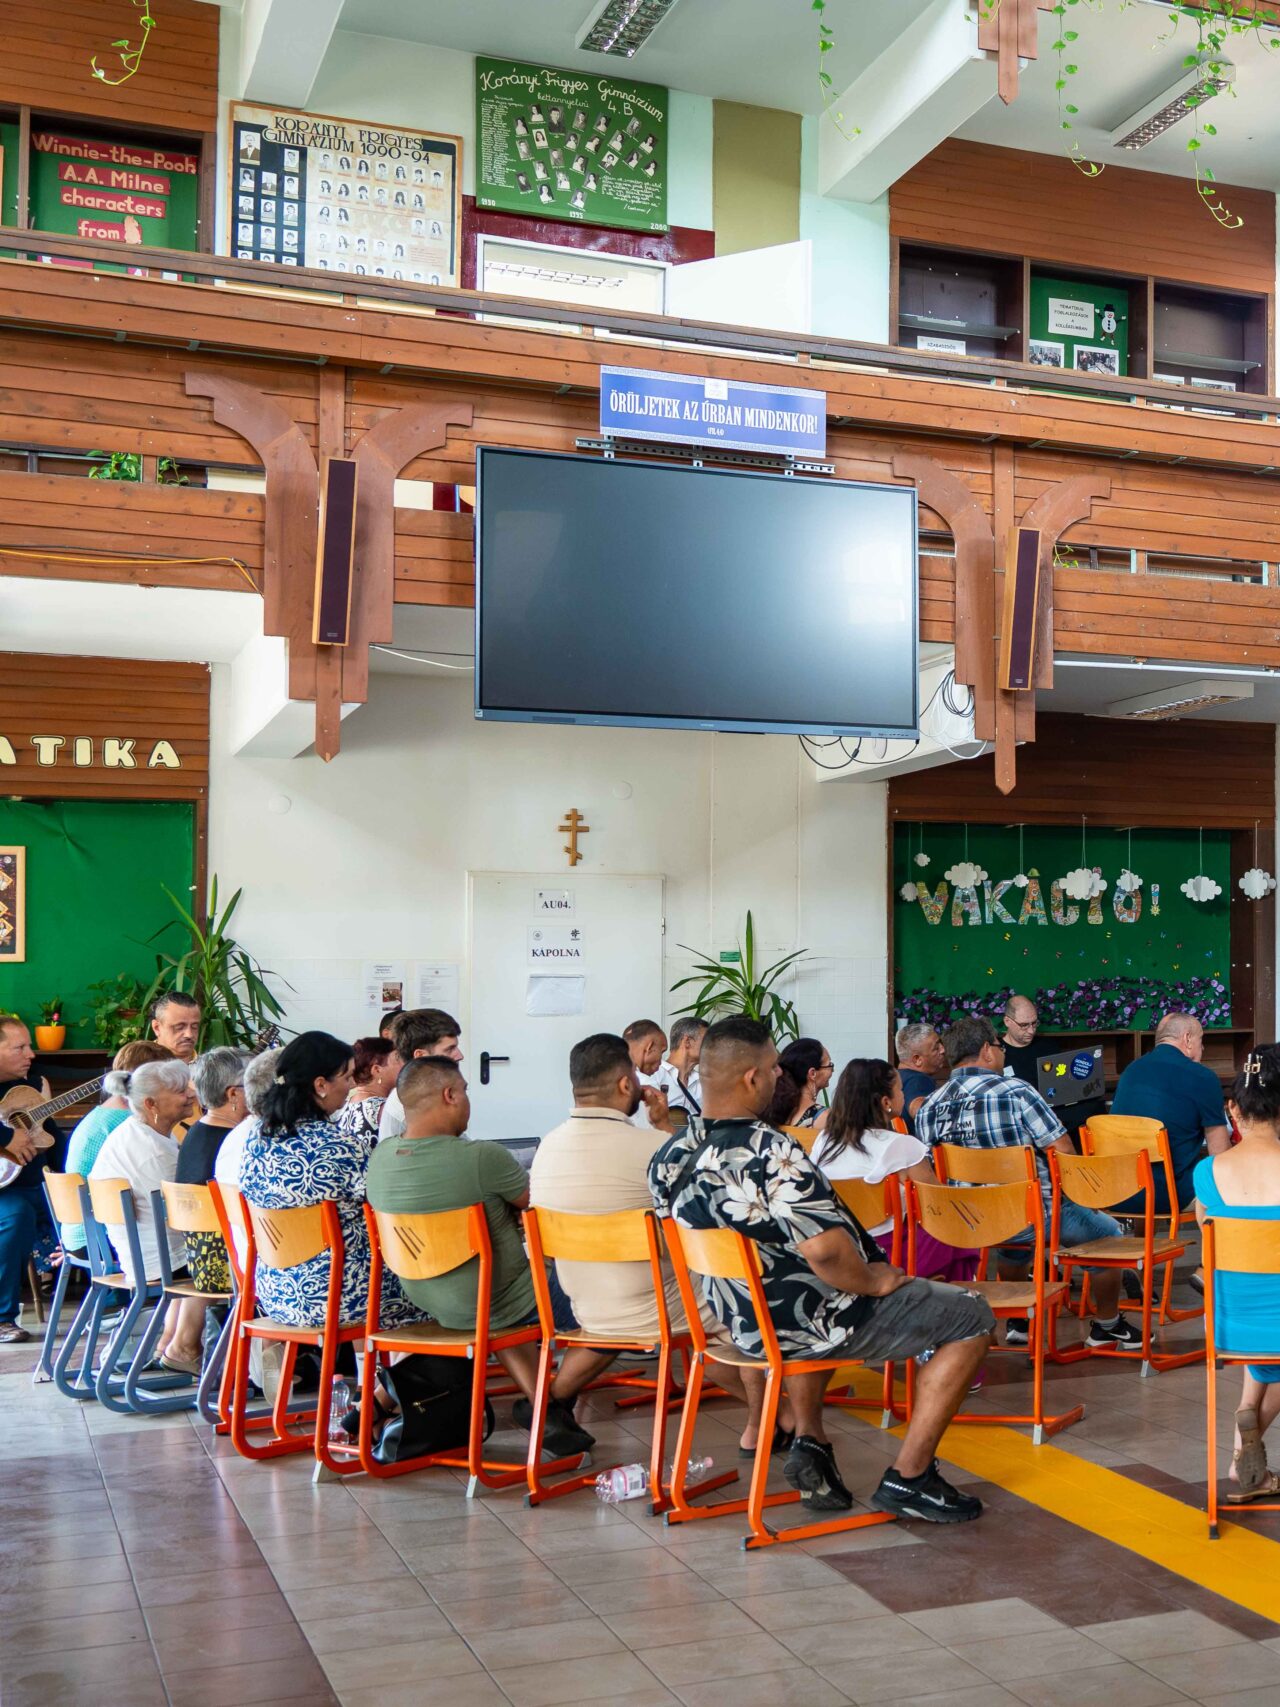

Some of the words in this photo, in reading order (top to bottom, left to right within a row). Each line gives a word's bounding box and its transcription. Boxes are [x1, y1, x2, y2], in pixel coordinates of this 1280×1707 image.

[480, 68, 541, 93] Korányi
[540, 70, 589, 94] Frigyes
[598, 79, 663, 122] Gimnázium
[262, 128, 354, 153] GIMNÁZIUM
[275, 116, 345, 139] KORÁNYI
[359, 130, 424, 150] FRIGYES
[32, 133, 196, 174] Winnie-the-Pooh
[111, 171, 164, 193] Milne
[62, 188, 162, 217] characters
[78, 221, 120, 240] from
[610, 390, 680, 420] ÖRÜLJETEK
[683, 402, 699, 421] AZ
[701, 400, 742, 427] ÚRBAN
[744, 408, 818, 434] MINDENKOR!
[542, 901, 571, 909] AU04.
[532, 947, 580, 957] KÁPOLNA
